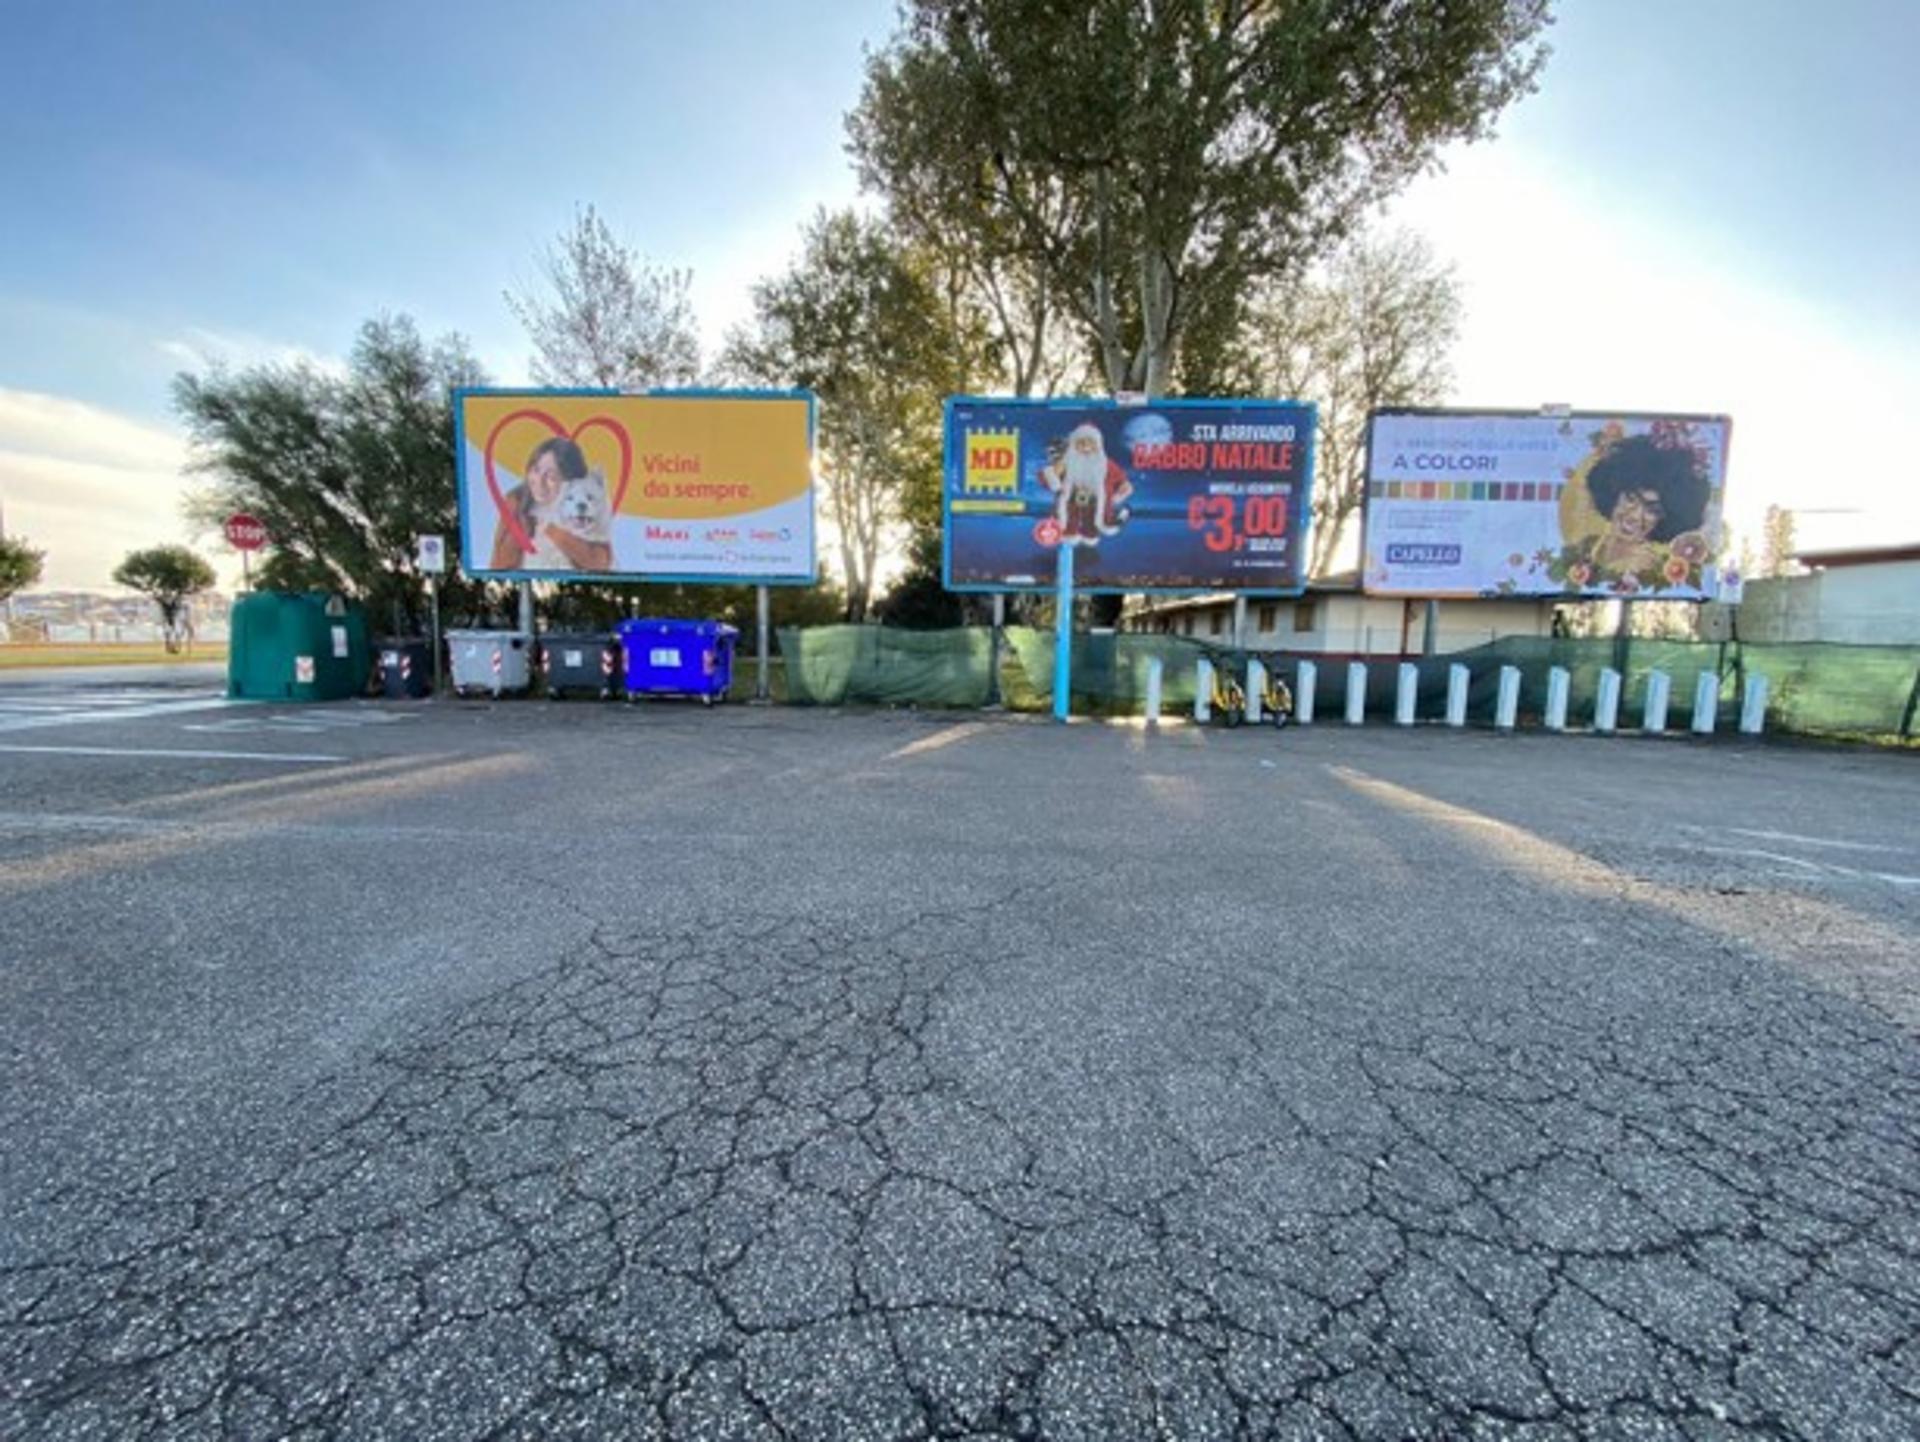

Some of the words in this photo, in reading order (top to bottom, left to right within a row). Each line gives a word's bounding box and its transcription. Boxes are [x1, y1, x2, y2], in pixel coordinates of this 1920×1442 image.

[1193, 425, 1216, 442] STA
[1220, 425, 1296, 442] ARRIVANDO
[643, 454, 700, 474] Vicini
[970, 447, 1014, 471] MD
[1131, 442, 1207, 470] BABBO
[1212, 443, 1292, 471] NATALE
[1392, 454, 1408, 470] A
[1415, 454, 1499, 470] COLORI
[644, 481, 670, 498] da
[227, 525, 265, 541] STOP
